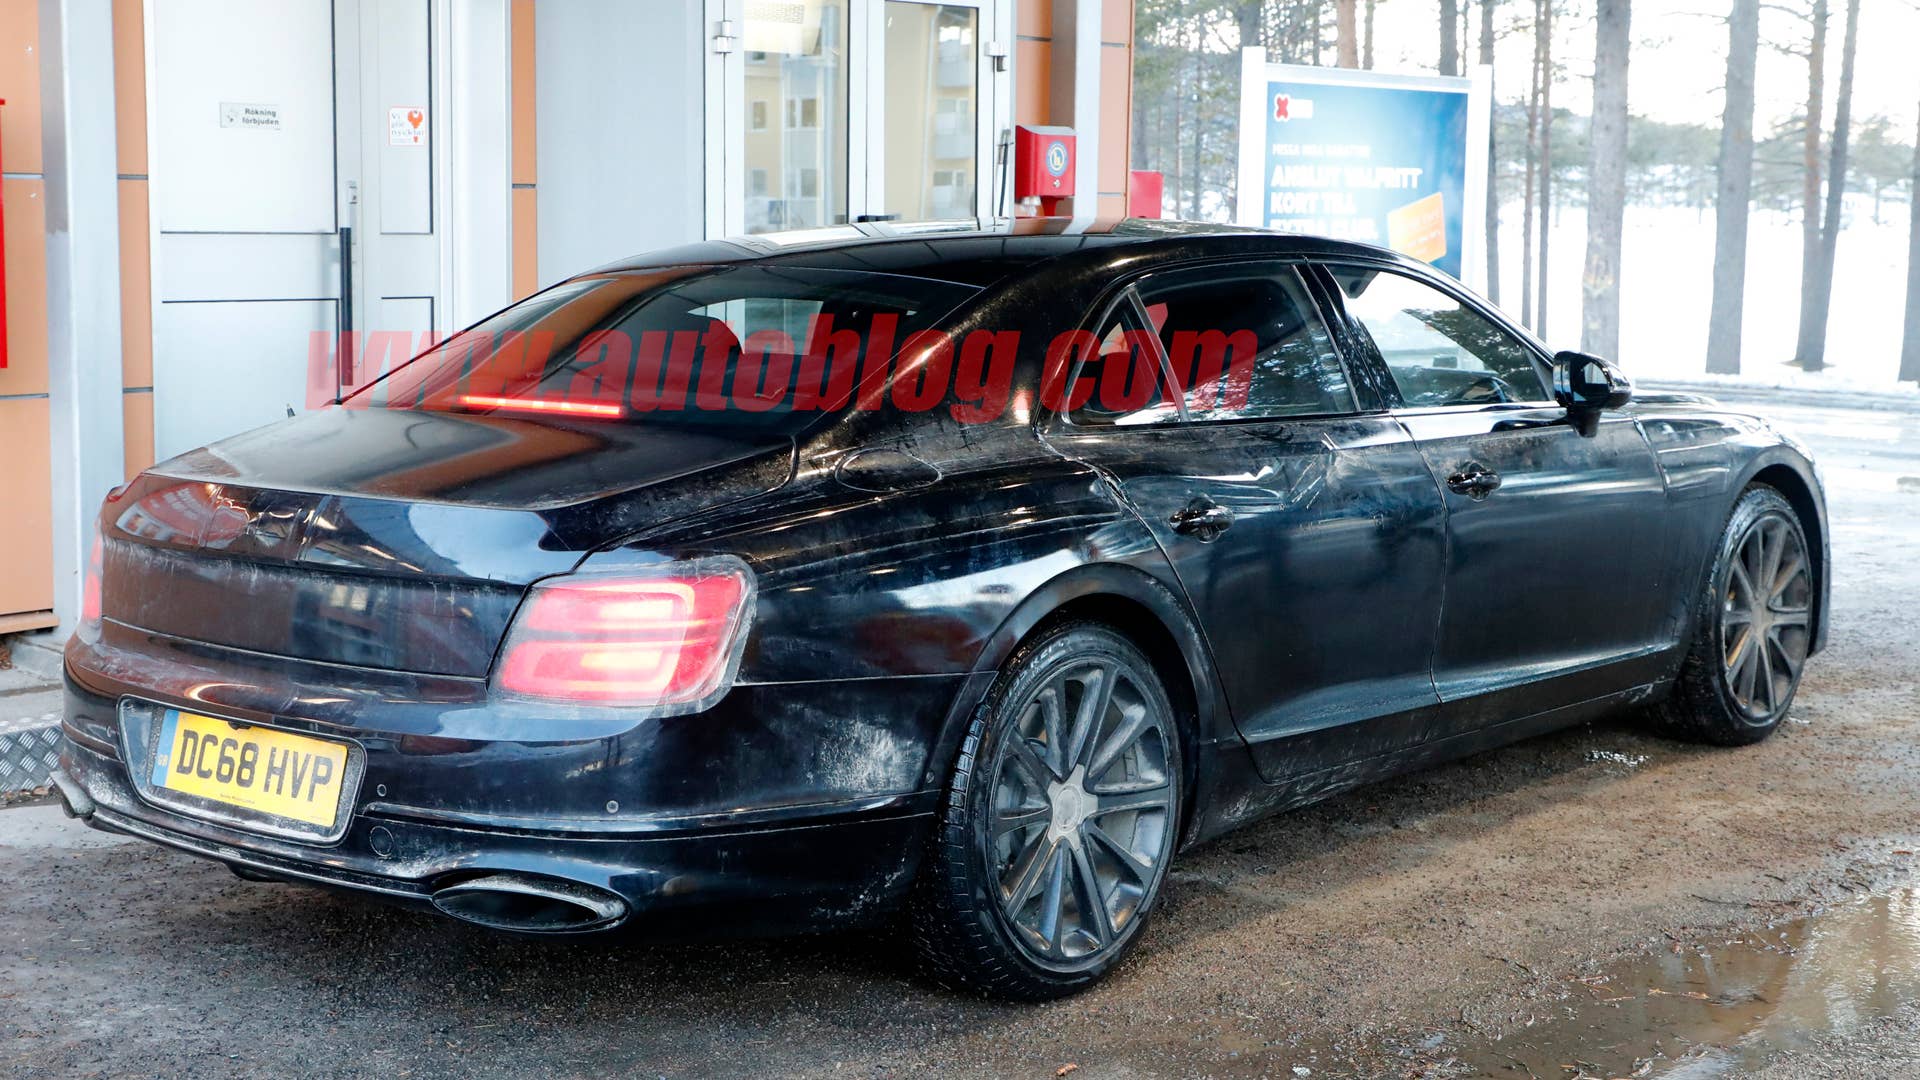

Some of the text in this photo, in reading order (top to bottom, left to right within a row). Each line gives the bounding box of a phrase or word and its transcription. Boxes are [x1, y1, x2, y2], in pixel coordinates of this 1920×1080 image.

[242, 116, 280, 126] förbjuden
[244, 107, 277, 118] Rökning
[1270, 191, 1359, 214] KORT TILL
[176, 729, 333, 803] DC68 HVP
